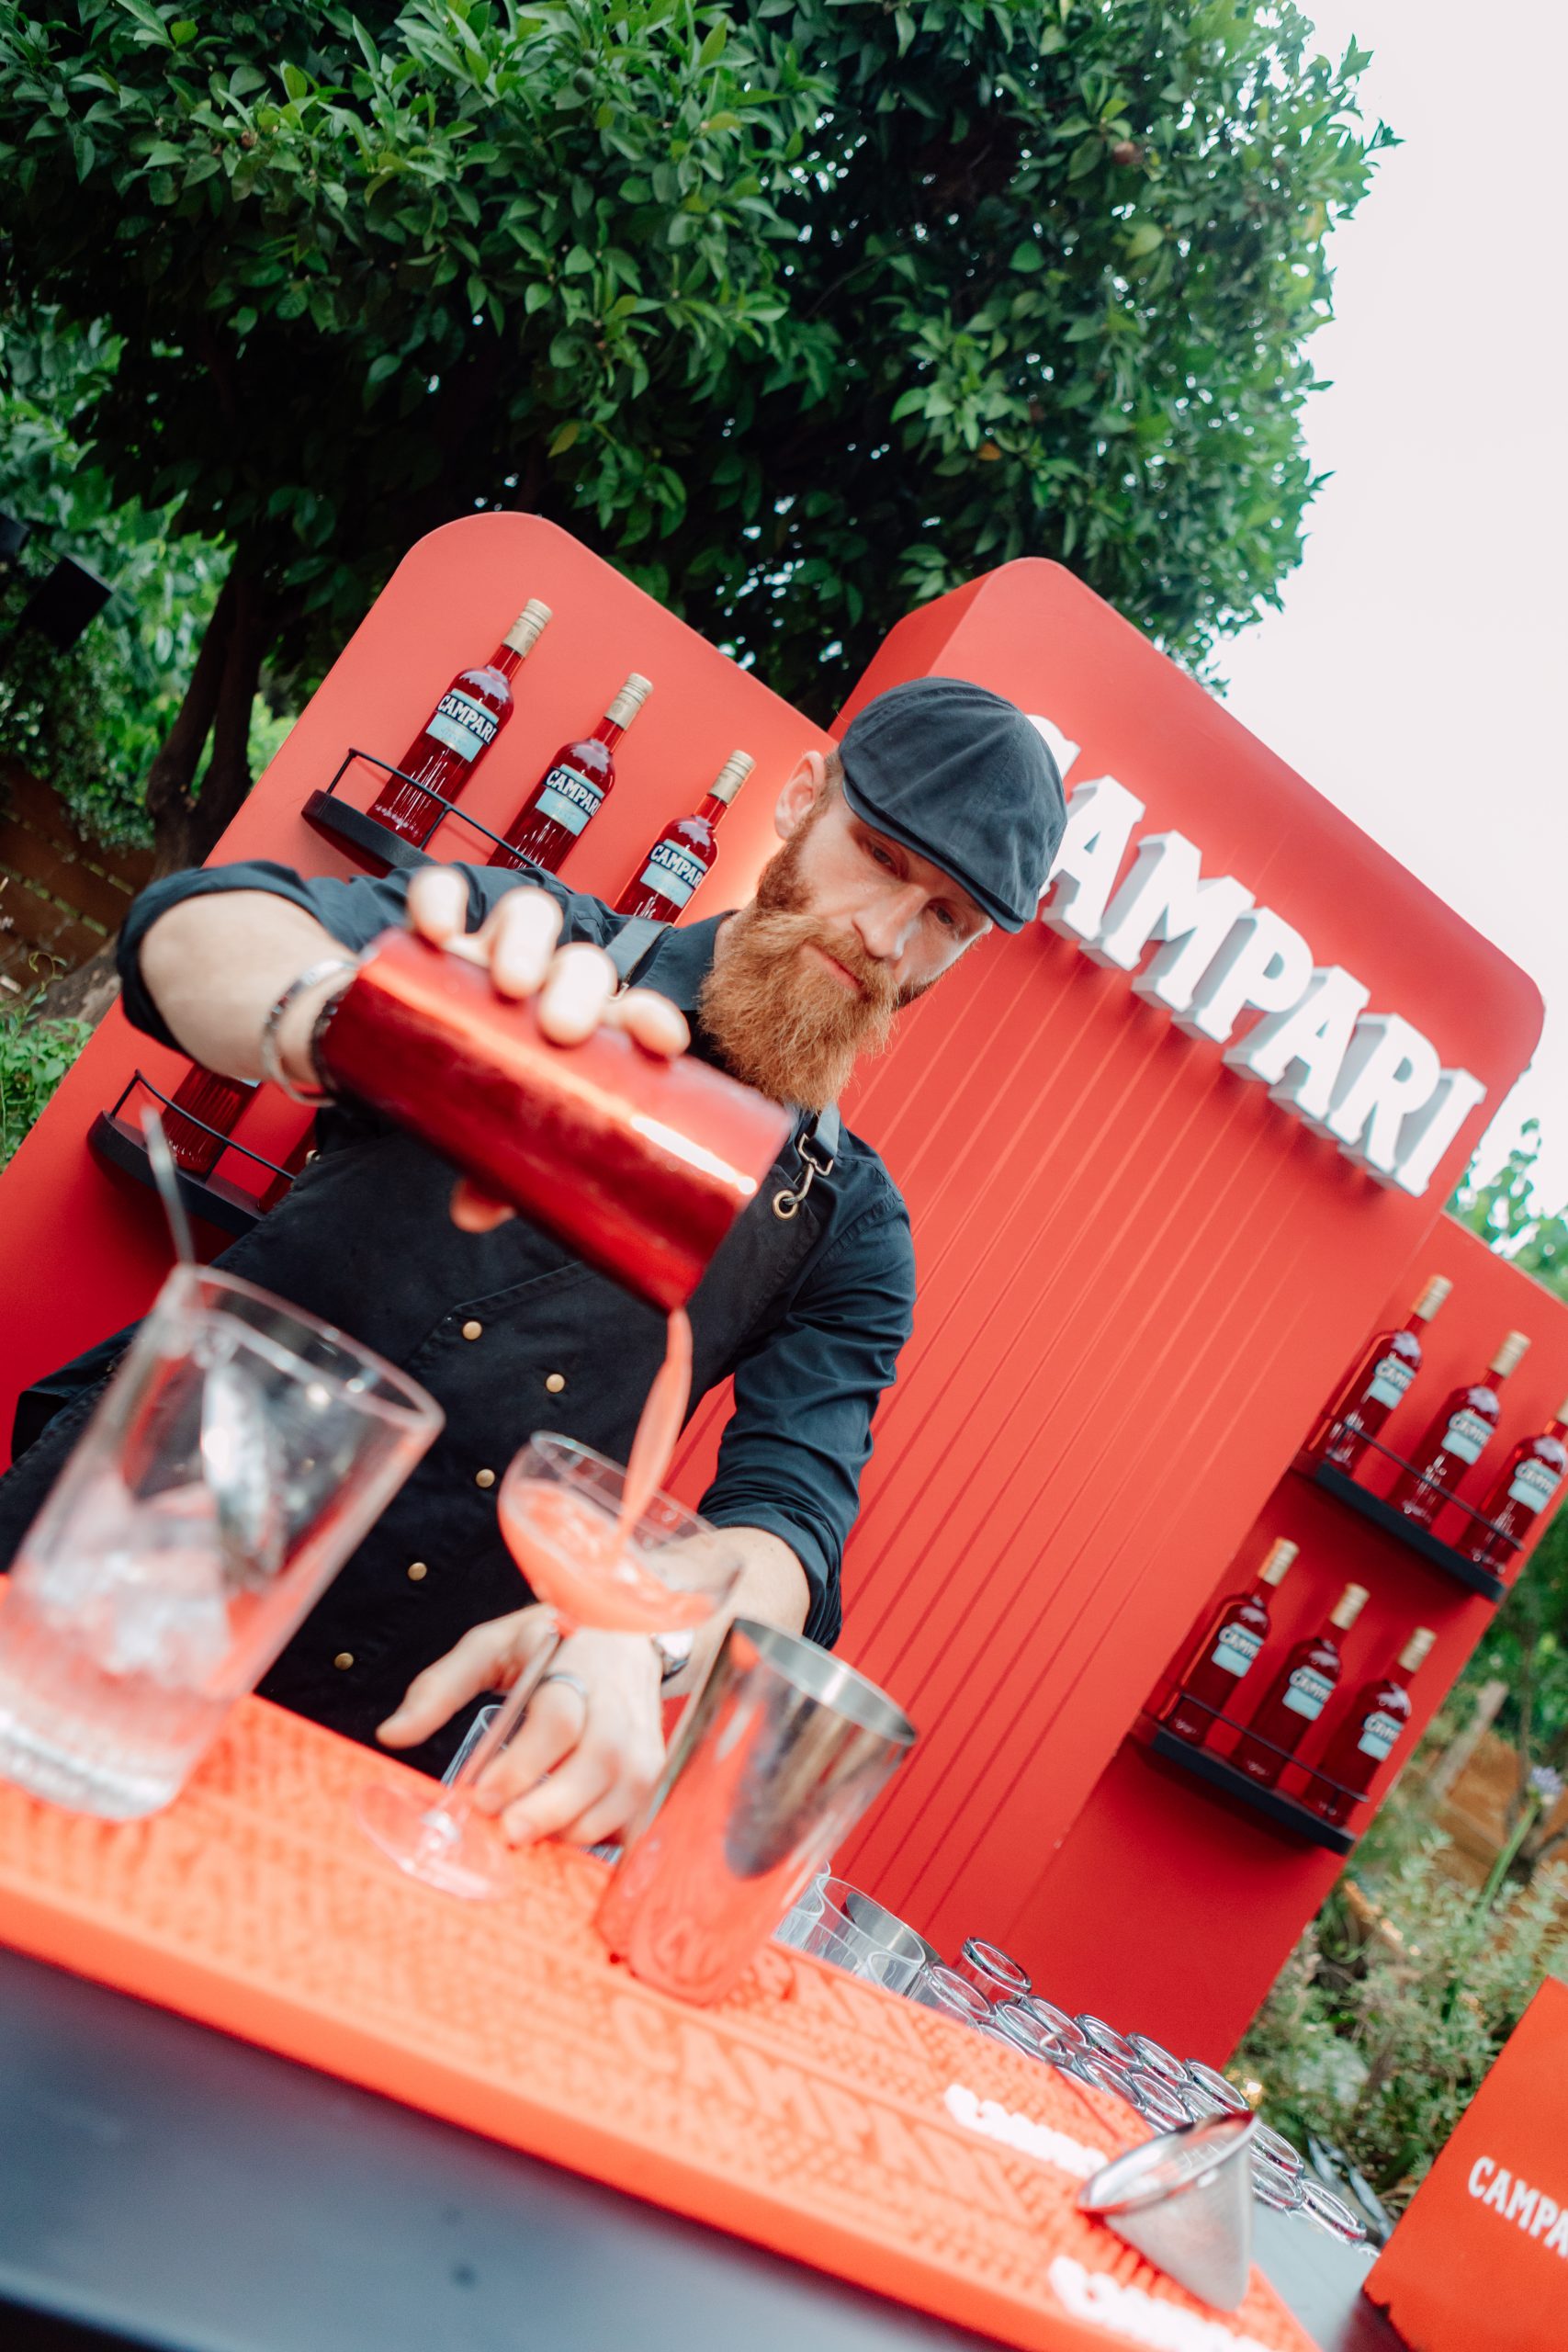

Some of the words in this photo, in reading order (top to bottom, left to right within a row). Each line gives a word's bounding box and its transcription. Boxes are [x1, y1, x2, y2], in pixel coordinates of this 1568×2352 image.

[437, 695, 497, 743] CAMPARI
[1024, 715, 1487, 1197] AMPARI
[1468, 2155, 1568, 2258] CAMPA
